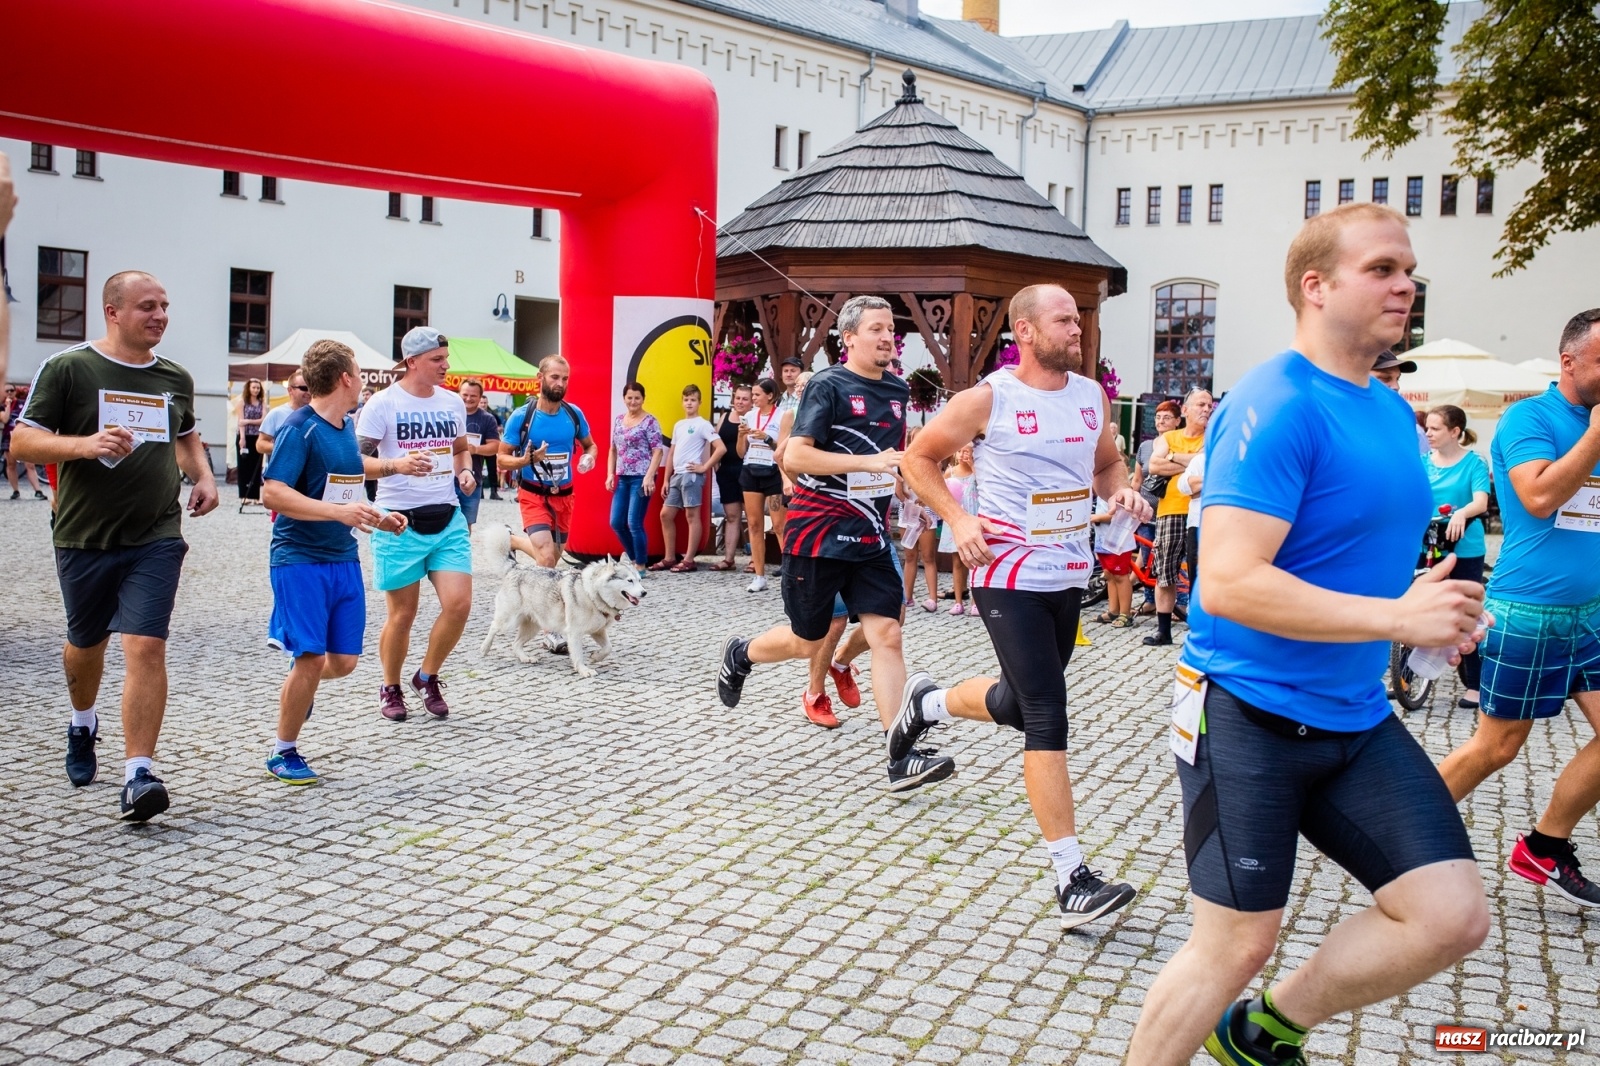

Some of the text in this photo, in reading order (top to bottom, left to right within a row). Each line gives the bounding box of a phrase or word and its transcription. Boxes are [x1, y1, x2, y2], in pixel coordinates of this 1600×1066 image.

[515, 270, 524, 283] B
[688, 339, 712, 366] SI
[360, 369, 398, 385] gofry
[444, 375, 540, 391] SOTY LODOWE
[127, 410, 144, 423] 57
[396, 411, 456, 426] HOUSE
[397, 420, 458, 440] BRAND
[397, 439, 453, 449] Vintage Clothi
[870, 472, 883, 482] 58
[342, 489, 353, 500] 60
[1588, 495, 1600, 510] 48
[1056, 508, 1073, 523] 45
